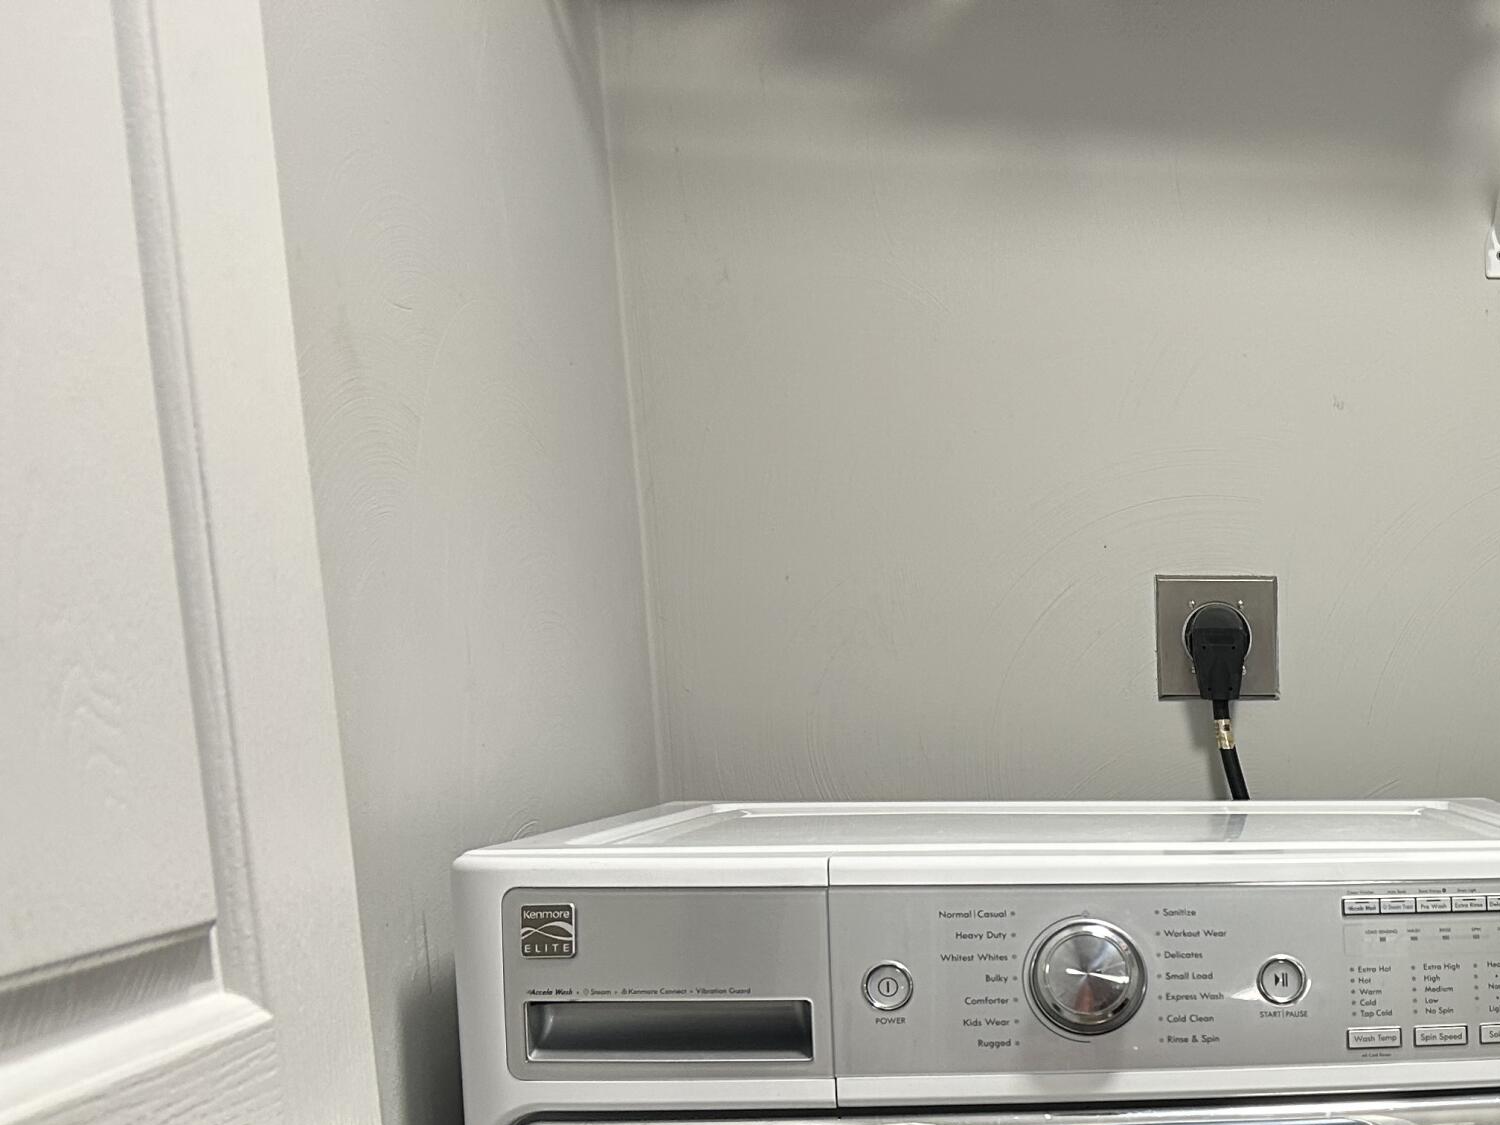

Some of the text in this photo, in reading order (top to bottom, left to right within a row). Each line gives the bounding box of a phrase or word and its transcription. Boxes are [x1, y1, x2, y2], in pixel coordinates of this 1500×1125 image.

[523, 910, 570, 919] Kenmore
[1162, 908, 1197, 917] Sanitize
[955, 930, 1007, 940] Heavy Duty
[1164, 929, 1227, 938] Workout Wear
[524, 943, 570, 953] ELITE
[940, 953, 1009, 962] Whitest Whites
[1164, 950, 1203, 959] Delicates
[1443, 962, 1461, 972] High
[985, 974, 1009, 984] Bulky
[1165, 971, 1214, 981] Small Load
[1423, 974, 1441, 983] High
[964, 996, 1009, 1005] Comforter
[1165, 991, 1225, 1002] Express Wash
[1359, 998, 1377, 1007] Cold
[1360, 1009, 1393, 1018] Tap Cold
[1425, 1006, 1454, 1015] No Spin
[875, 1016, 906, 1025] POWER
[963, 1018, 1010, 1027] Kids Wear
[1166, 1014, 1215, 1023] Cold Clean
[1167, 1034, 1220, 1044] Rinse & Spin
[1354, 1034, 1397, 1043] Wash Temp
[1420, 1032, 1463, 1042] Spin Speed
[977, 1038, 1012, 1049] Rugged
